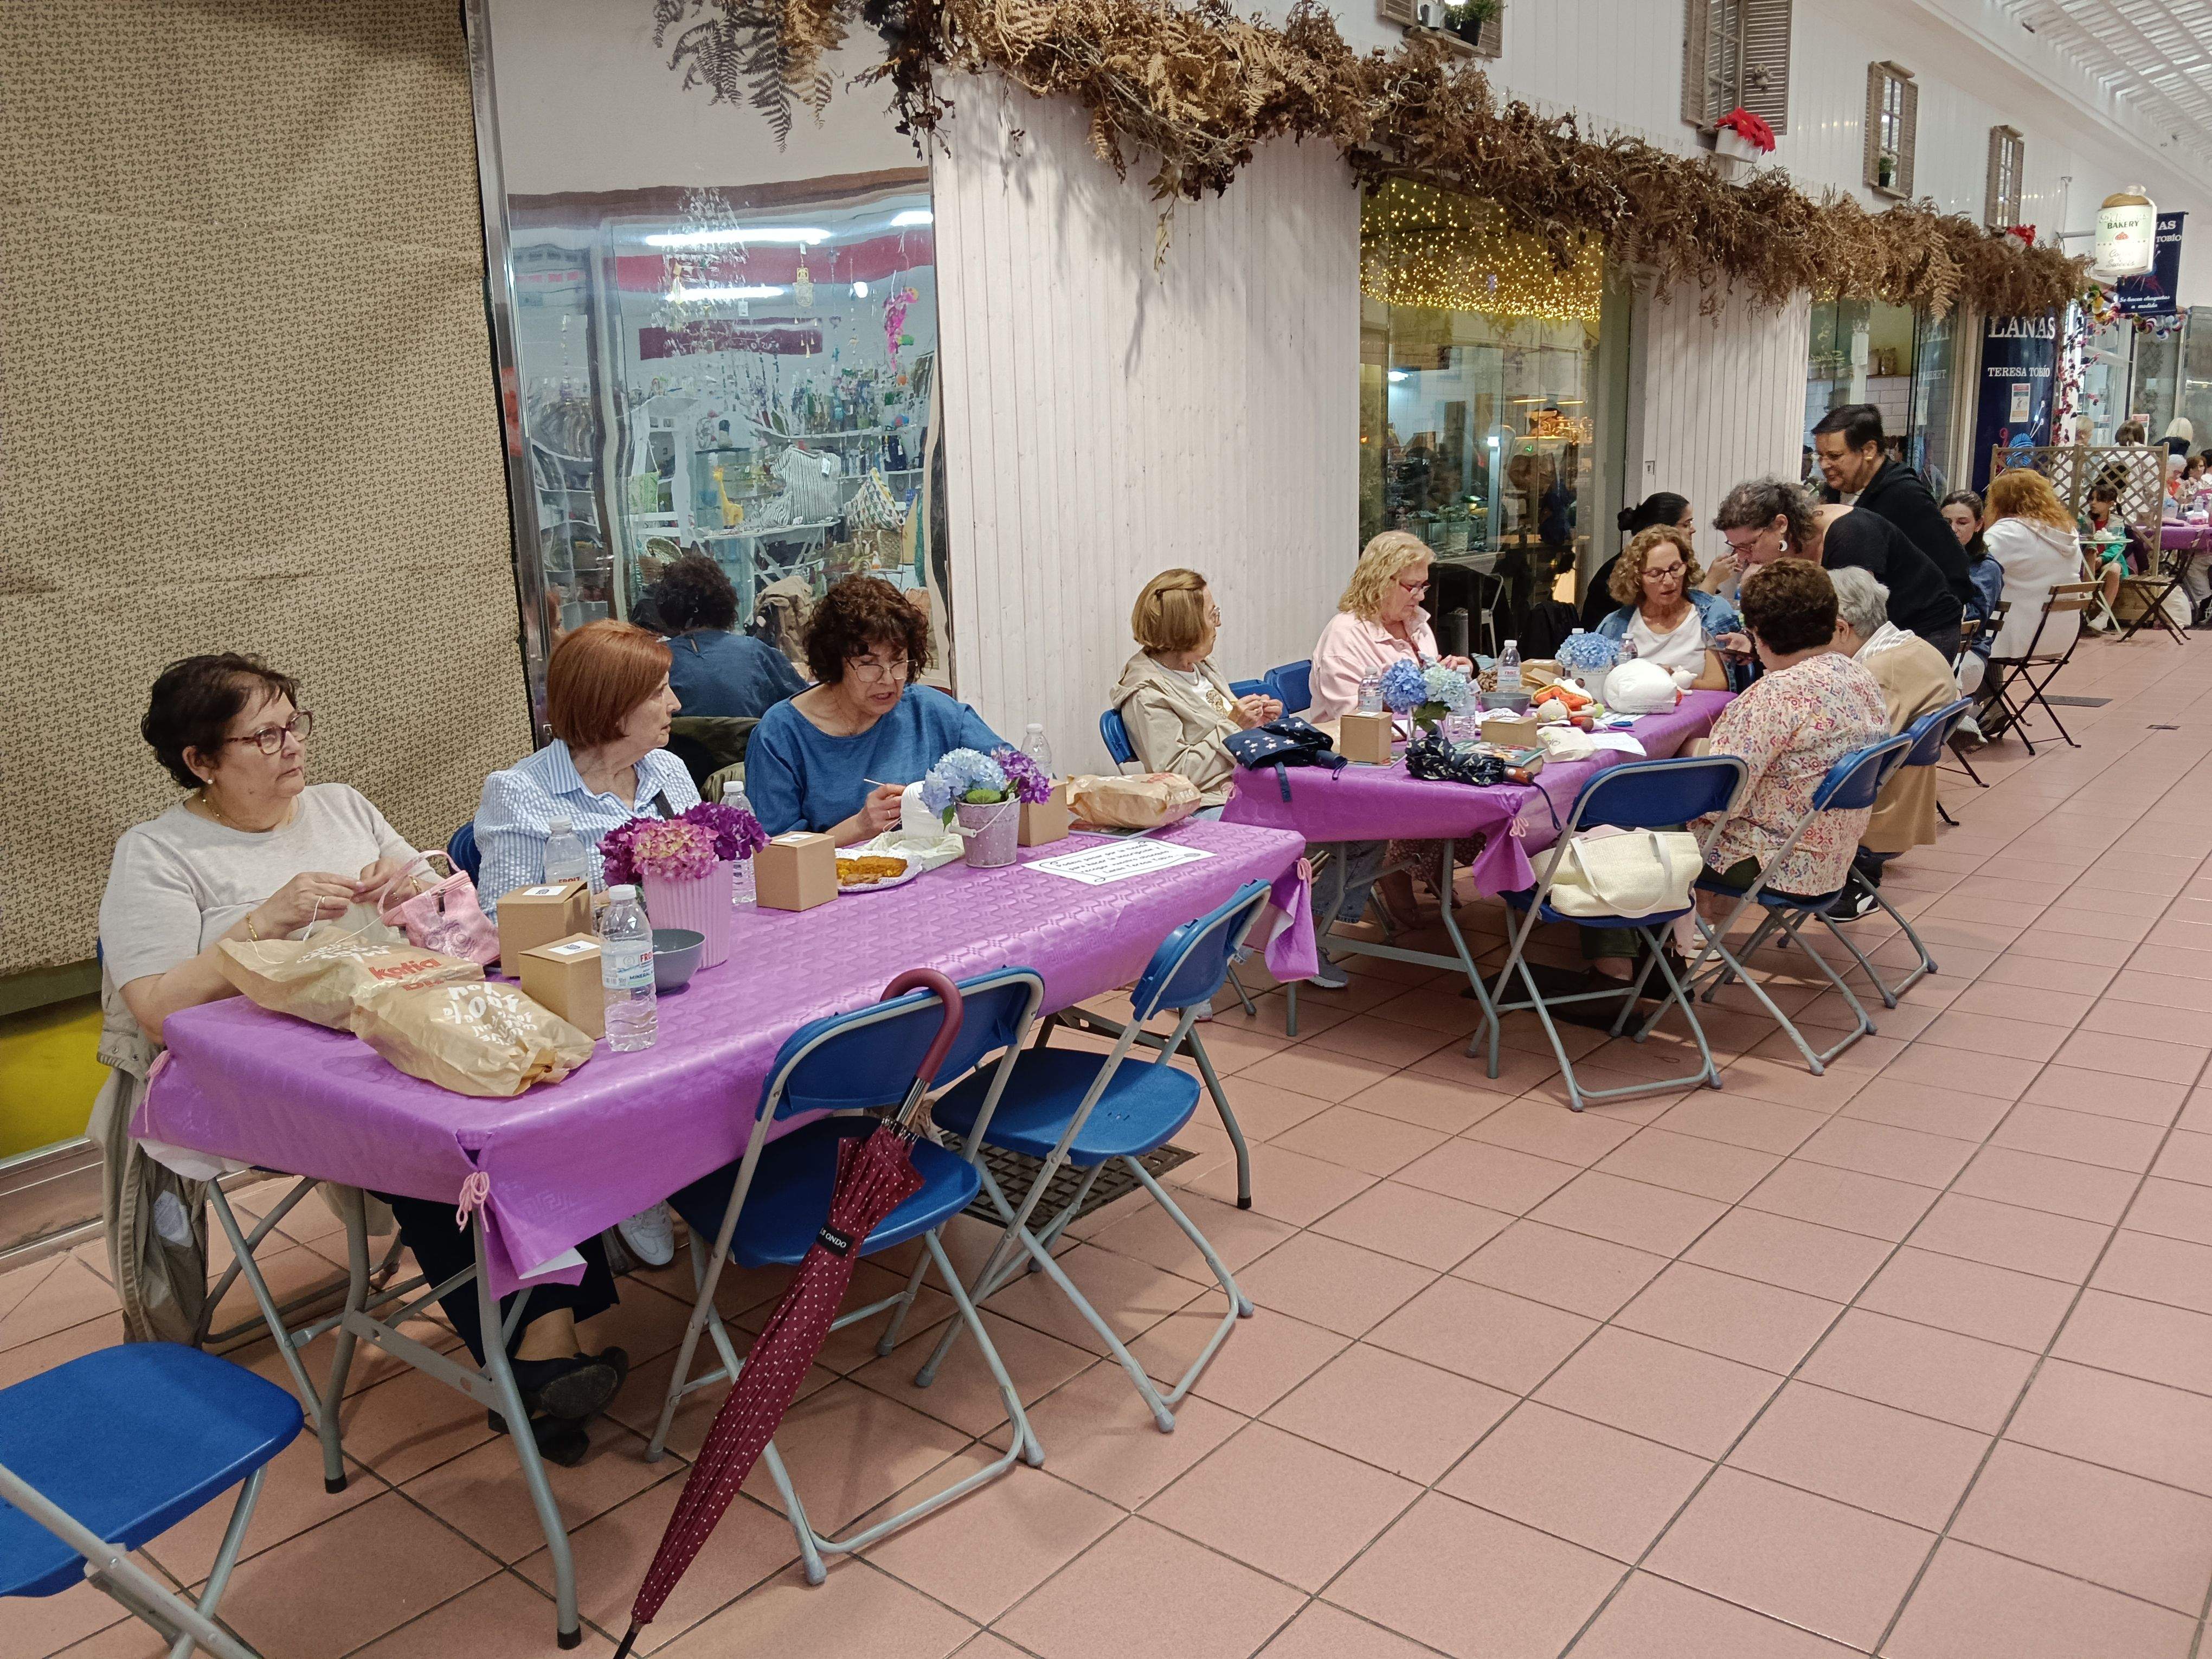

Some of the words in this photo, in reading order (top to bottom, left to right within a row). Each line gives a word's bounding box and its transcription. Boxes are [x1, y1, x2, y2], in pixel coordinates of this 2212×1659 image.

[2107, 221, 2139, 229] BAKERY
[1988, 316, 2055, 340] LANAS
[1988, 366, 2027, 377] TERESA
[2029, 365, 2050, 377] TOBÍO
[640, 951, 652, 962] FRO
[368, 958, 442, 980] katia
